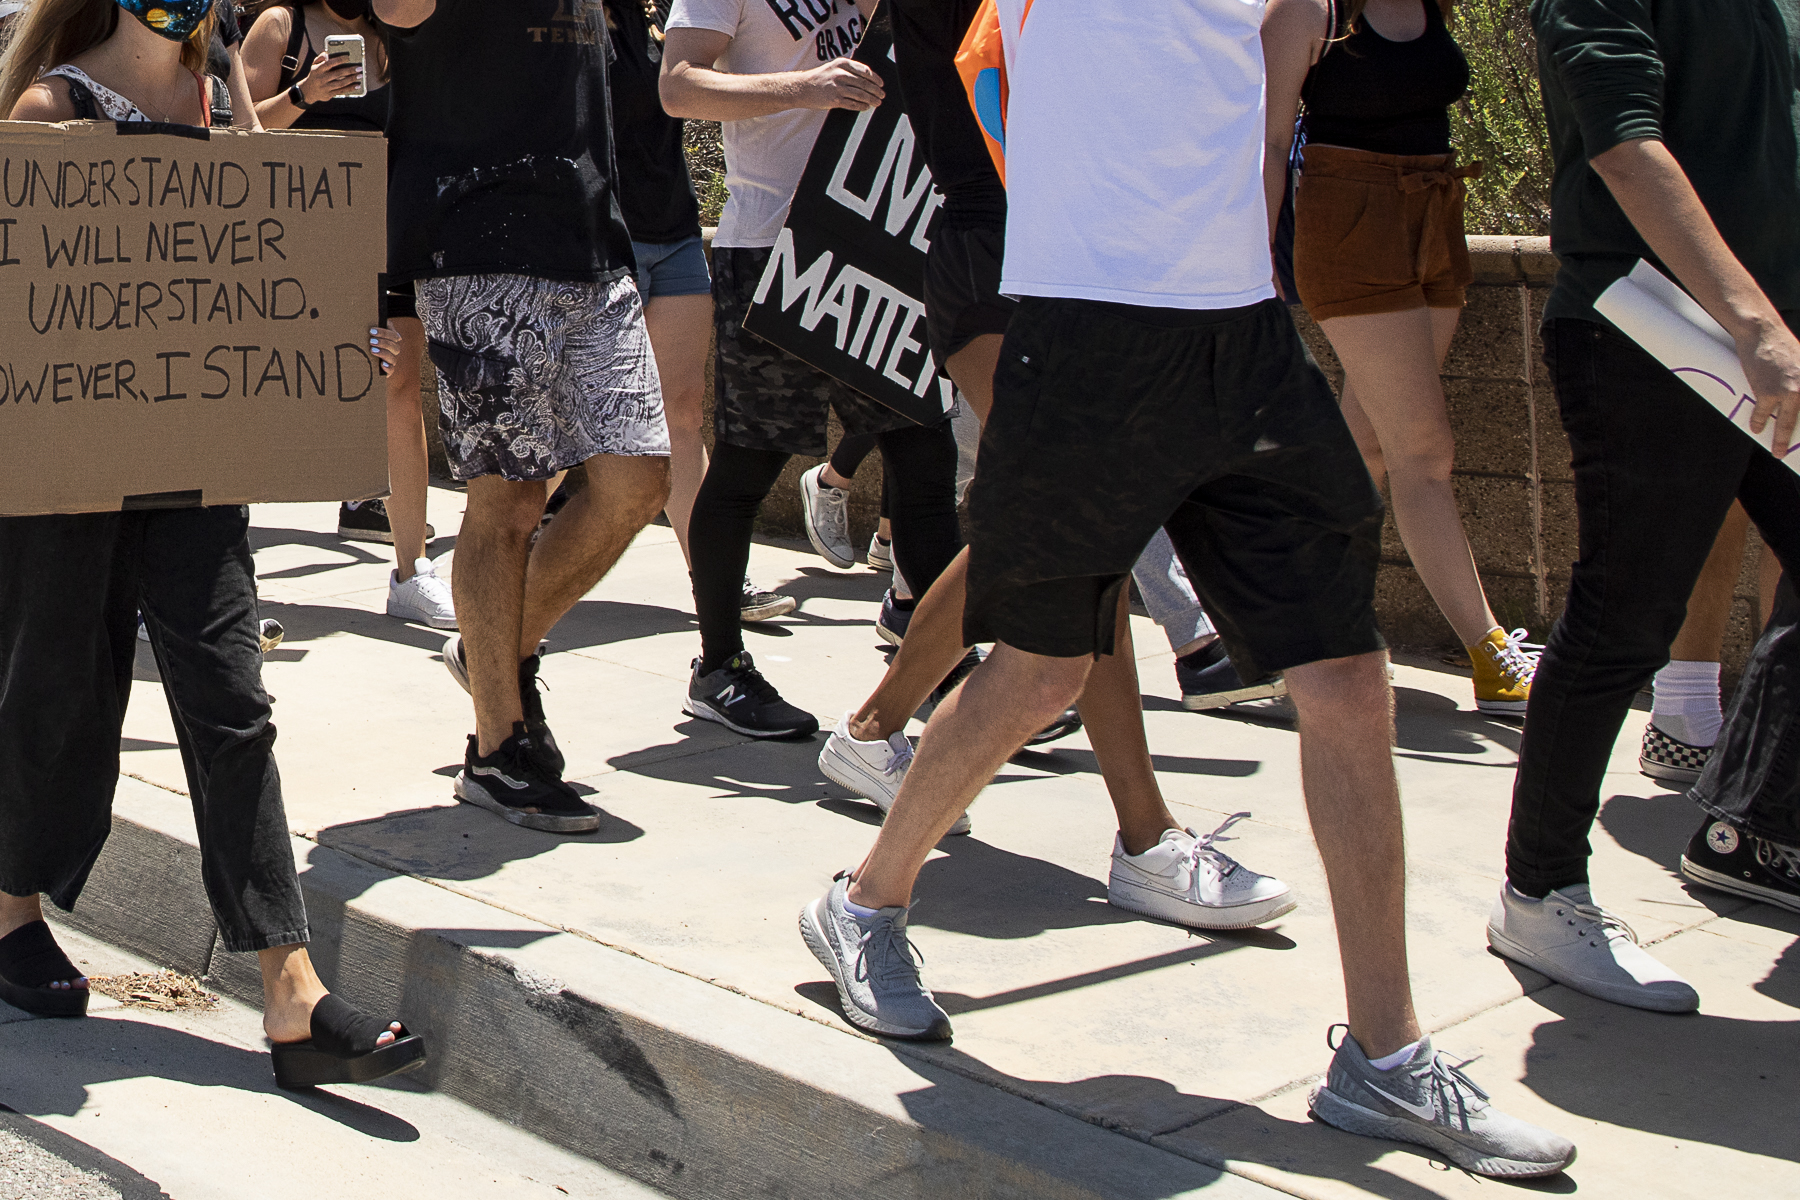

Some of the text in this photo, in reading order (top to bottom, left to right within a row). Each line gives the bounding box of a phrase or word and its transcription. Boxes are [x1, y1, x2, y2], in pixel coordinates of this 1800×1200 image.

[3, 155, 250, 212] UNDERSTAND
[261, 161, 363, 213] THAT
[41, 223, 132, 268] WILL
[145, 216, 287, 265] NEVER
[28, 276, 321, 336] UNDERSTAND.
[752, 227, 954, 403] MATTER
[199, 342, 374, 402] STAND
